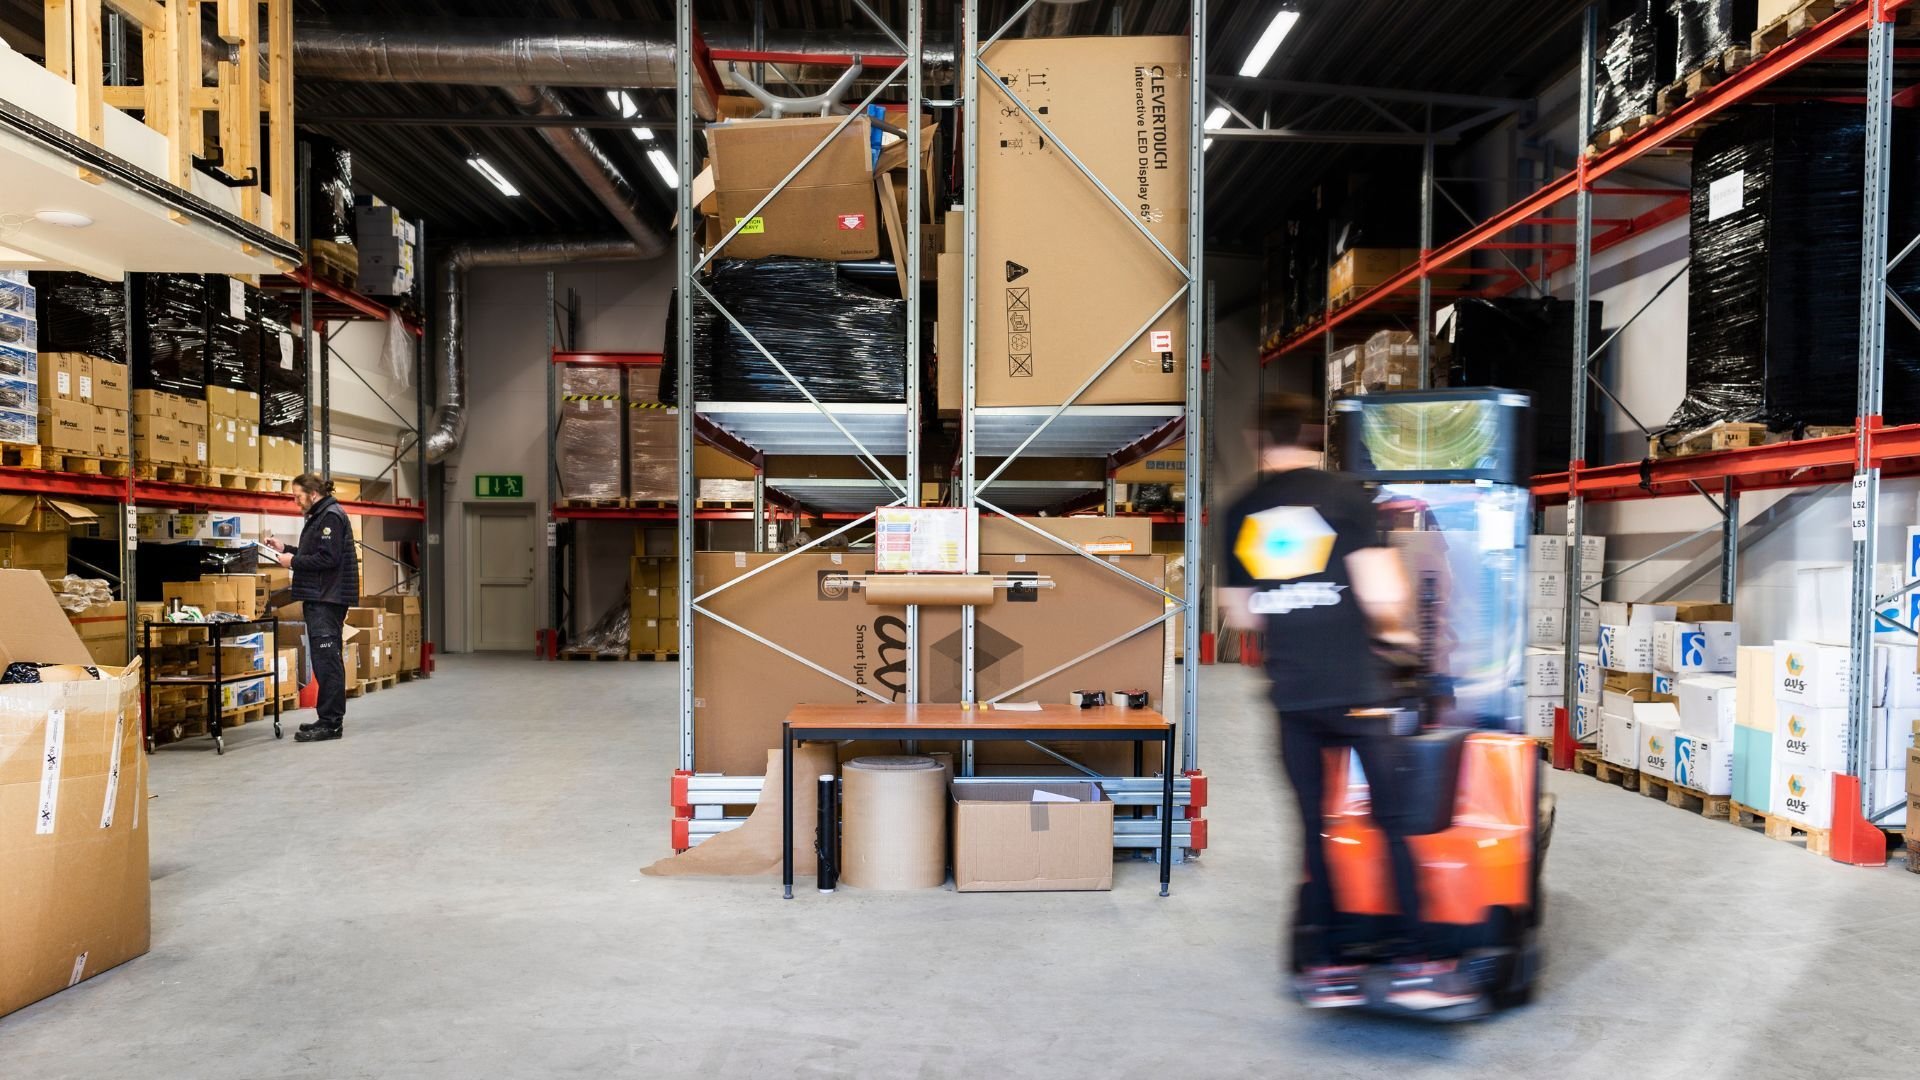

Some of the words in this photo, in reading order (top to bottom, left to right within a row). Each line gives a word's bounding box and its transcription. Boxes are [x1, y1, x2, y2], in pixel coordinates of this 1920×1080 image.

[1134, 66, 1147, 127] Interactive
[1150, 65, 1168, 170] CLEVERTOUCH
[1137, 130, 1148, 154] LED
[1137, 158, 1150, 201] Display
[1854, 480, 1866, 488] L51
[1852, 501, 1866, 509] L52
[1852, 519, 1866, 528] L53
[856, 624, 867, 660] Smart
[853, 663, 868, 685] ljud
[1784, 678, 1808, 691] avs
[1786, 739, 1810, 752] avs
[1647, 755, 1667, 767] avs
[1688, 740, 1697, 788] DELTACO
[1786, 798, 1810, 812] avs
